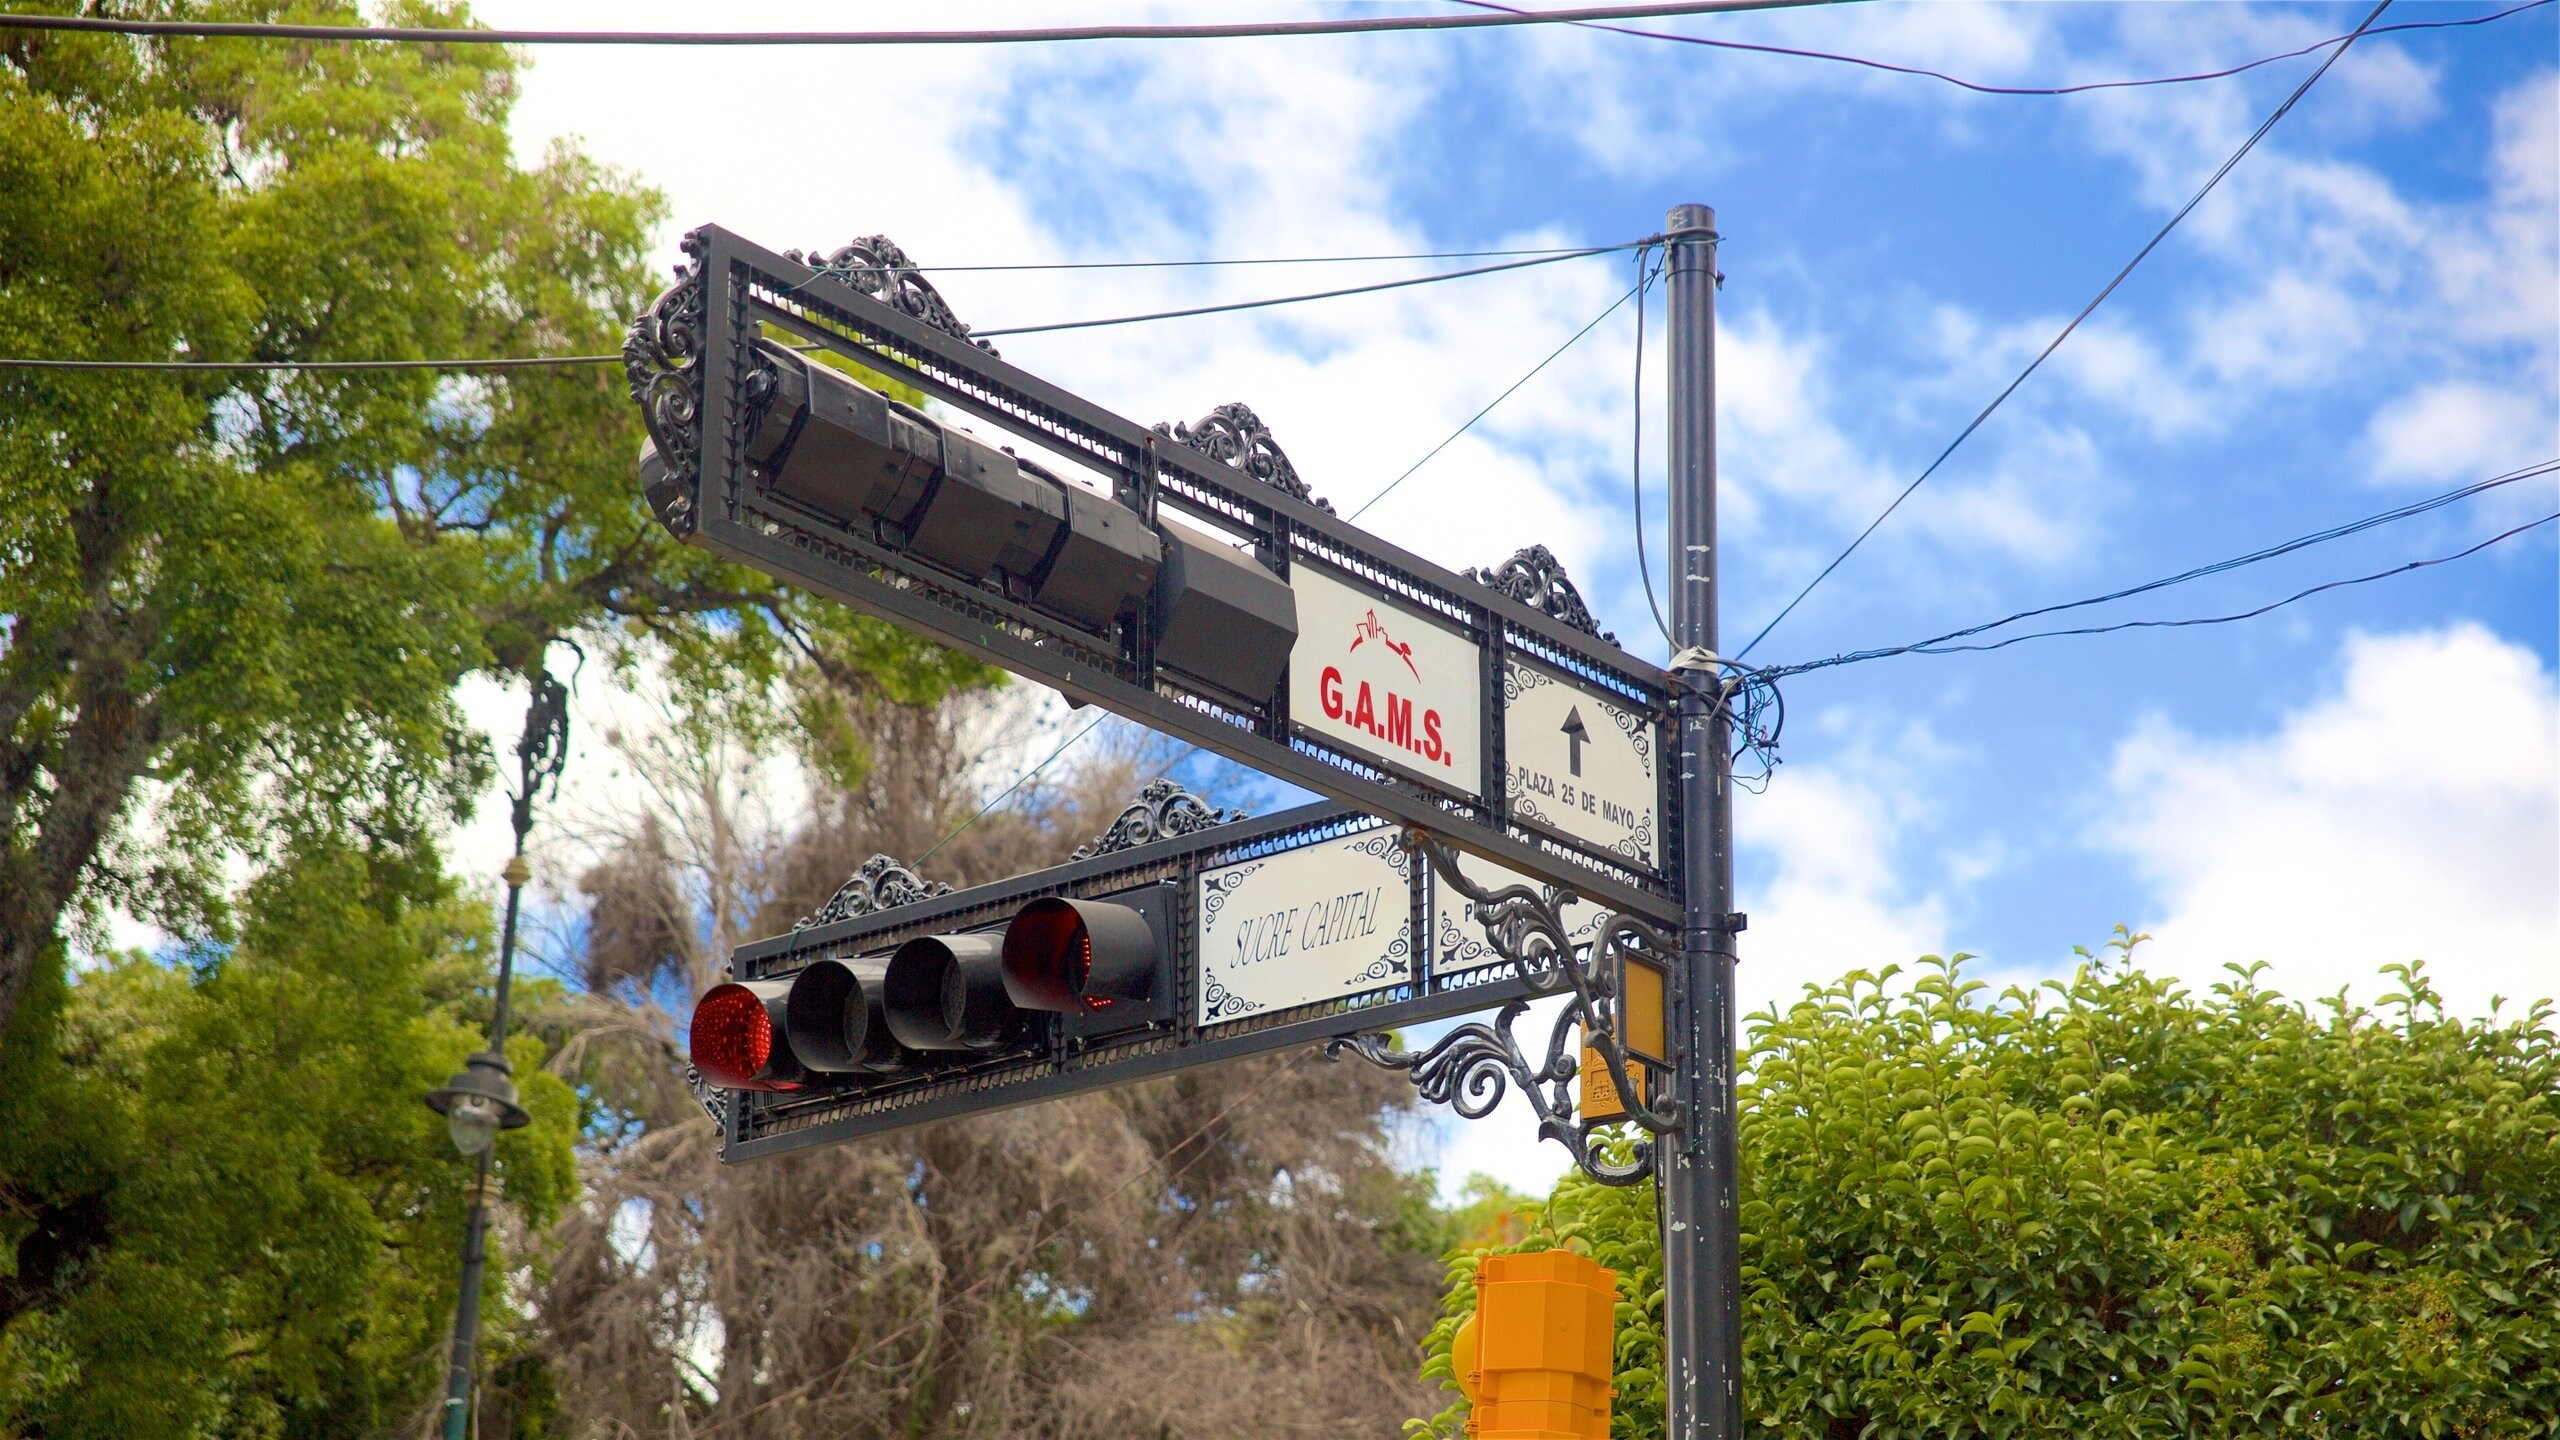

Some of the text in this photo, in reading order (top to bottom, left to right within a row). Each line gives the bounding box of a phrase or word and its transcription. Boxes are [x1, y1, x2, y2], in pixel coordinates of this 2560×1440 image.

[1320, 666, 1451, 768] G.A.M.S.
[1518, 766, 1634, 830] PLAZA 25 DE MAYO
[1230, 886, 1381, 969] SUCRE CAPITAL
